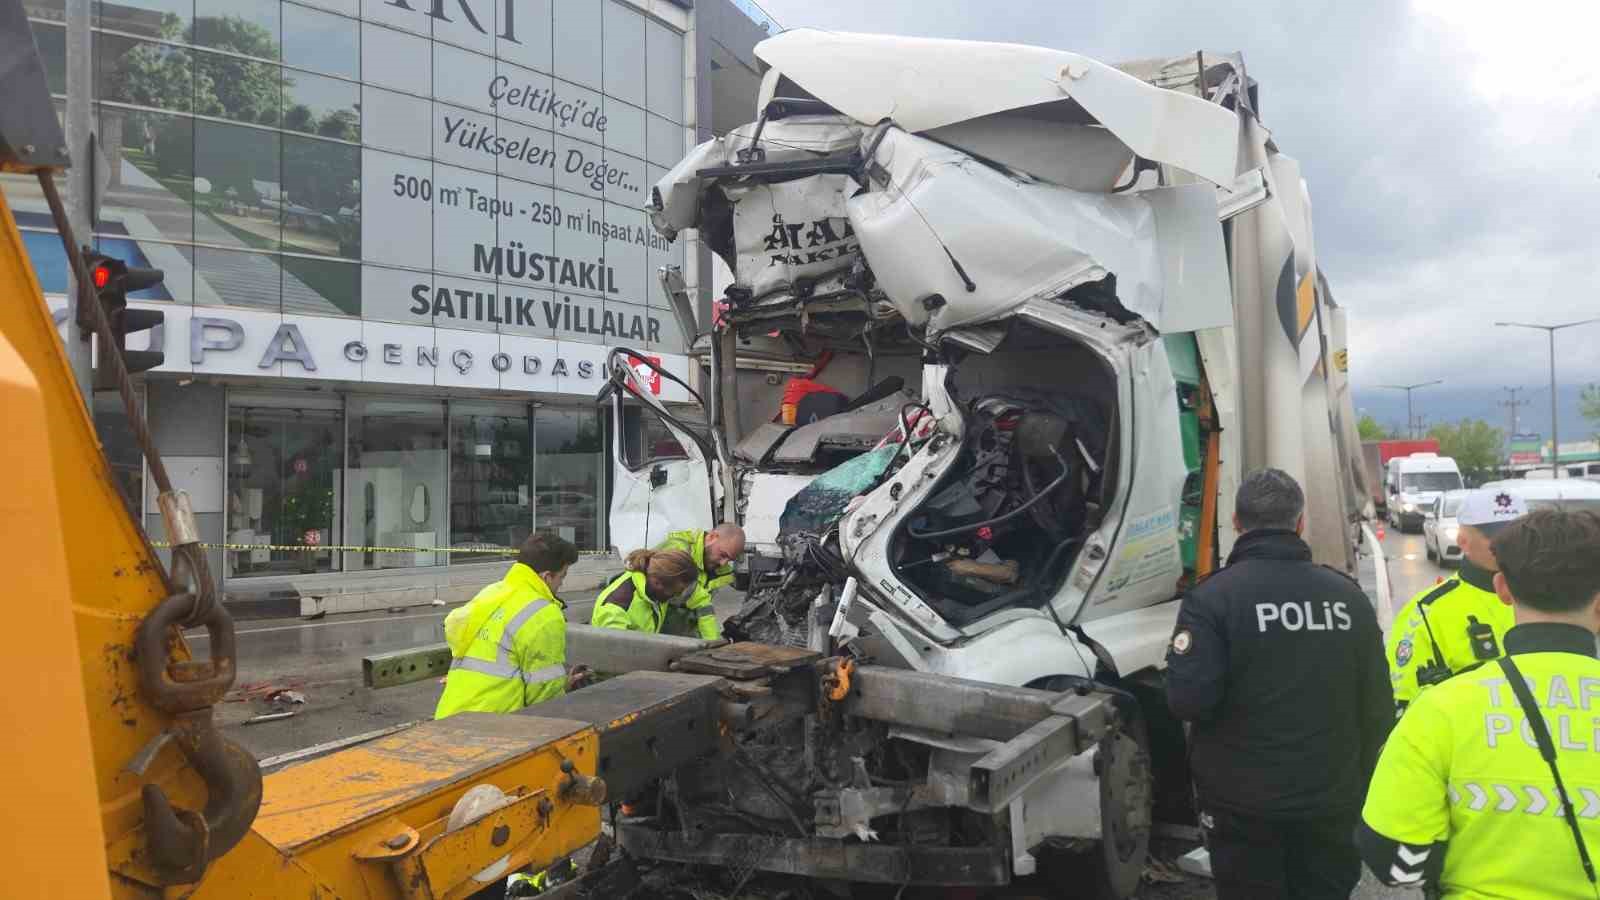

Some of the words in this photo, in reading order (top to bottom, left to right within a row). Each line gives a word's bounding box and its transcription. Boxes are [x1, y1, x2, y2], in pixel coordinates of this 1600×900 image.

[488, 76, 608, 132] Çeltikçi'de
[444, 116, 557, 168] Yükselen
[565, 150, 639, 192] Değer...
[393, 174, 432, 201] 500
[466, 187, 513, 219] Tapu
[531, 202, 562, 226] 250
[586, 208, 632, 242] İnşaat
[473, 241, 619, 294] MÜSTAKİL
[410, 284, 536, 327] SATILIK
[543, 296, 661, 344] VİLLALAR
[343, 341, 474, 376] GENÇ
